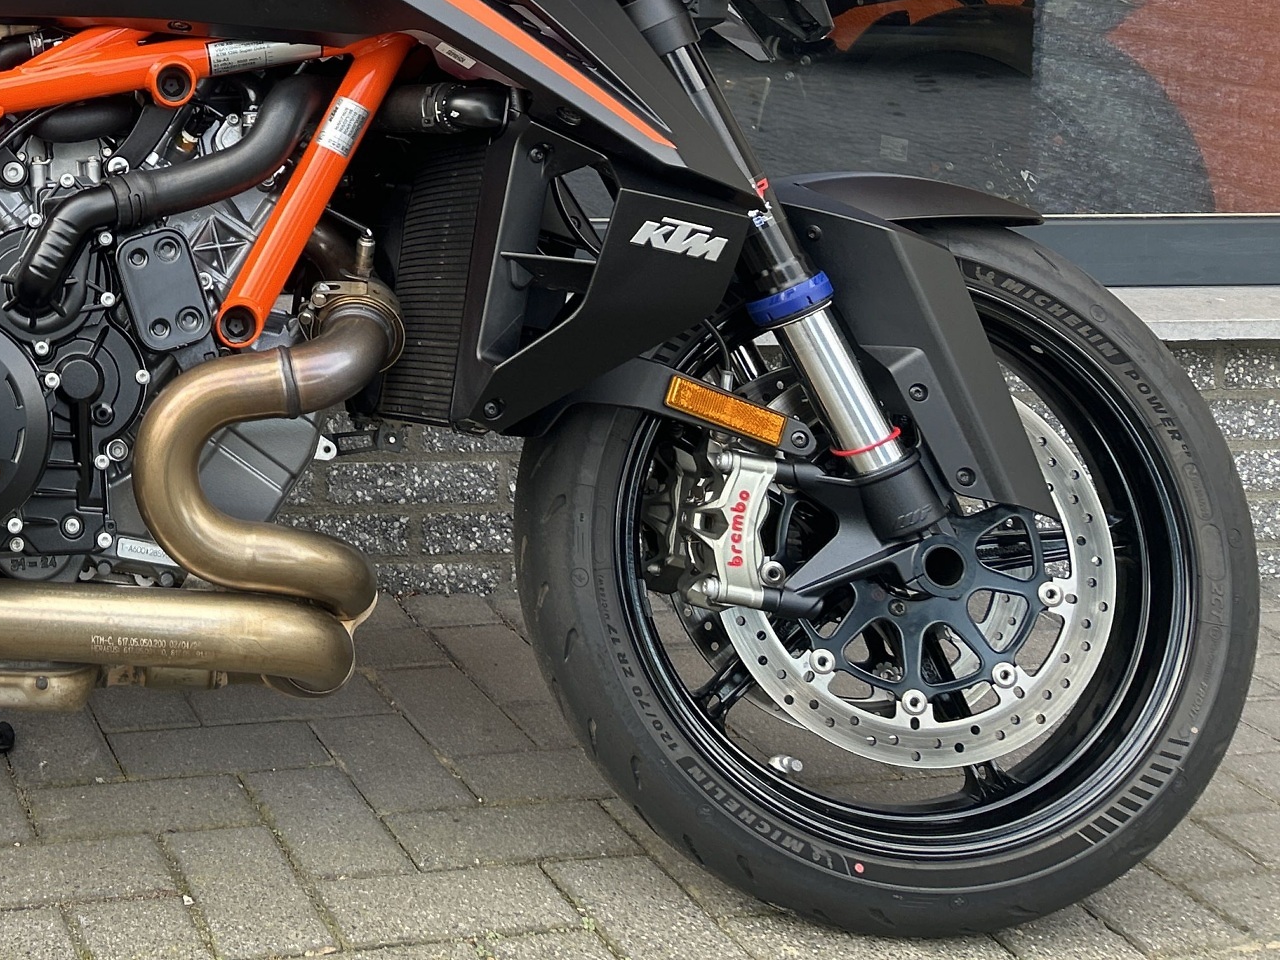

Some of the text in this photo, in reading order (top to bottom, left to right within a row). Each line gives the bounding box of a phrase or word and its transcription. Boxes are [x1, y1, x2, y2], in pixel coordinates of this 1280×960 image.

[630, 217, 728, 262] KTM
[1000, 278, 1120, 358] MICHELIN
[1124, 369, 1183, 443] POWER
[727, 489, 751, 568] brembo
[607, 623, 621, 645] 17
[616, 651, 635, 679] ZR
[631, 684, 677, 752] 120/70
[686, 764, 805, 855] MICHELIN
